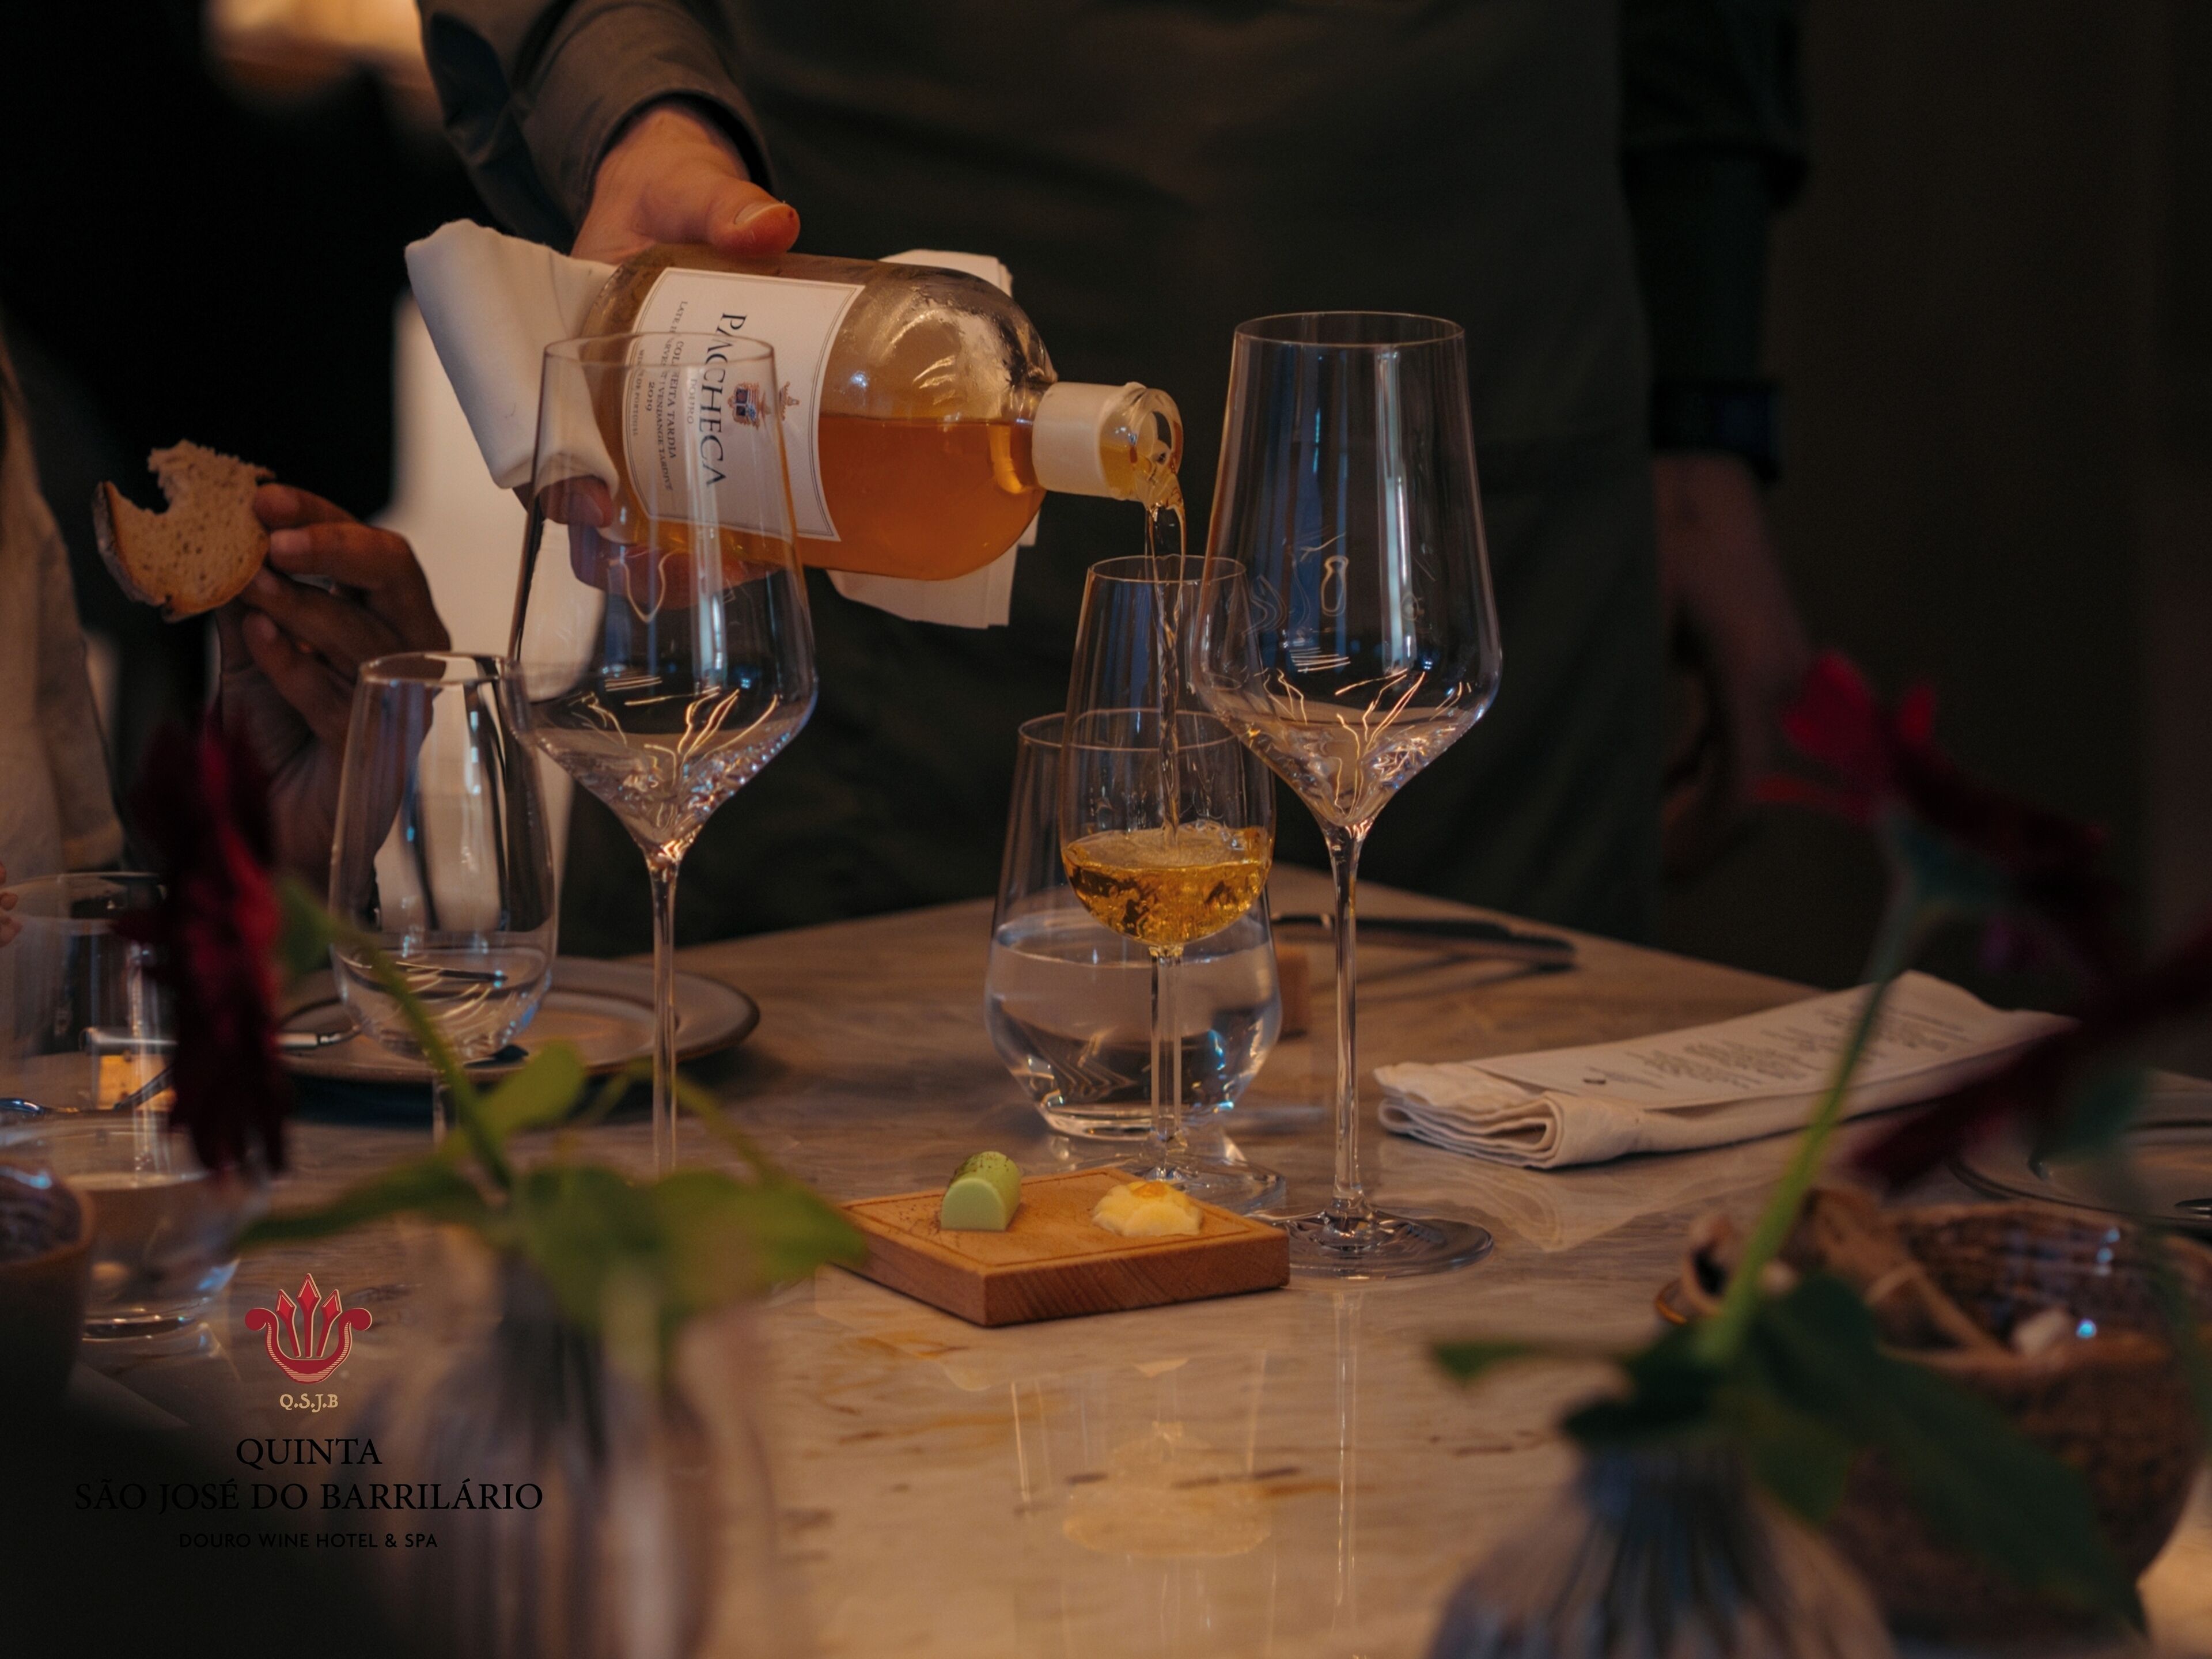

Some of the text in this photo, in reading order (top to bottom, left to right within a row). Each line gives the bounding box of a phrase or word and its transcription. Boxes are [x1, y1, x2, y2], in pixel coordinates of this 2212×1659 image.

[672, 301, 688, 325] LATE
[645, 381, 655, 412] 2019
[655, 387, 665, 446] VENDANGE
[687, 378, 697, 424] DOURO
[699, 313, 747, 487] PACHECA
[666, 412, 676, 459] TARDIA
